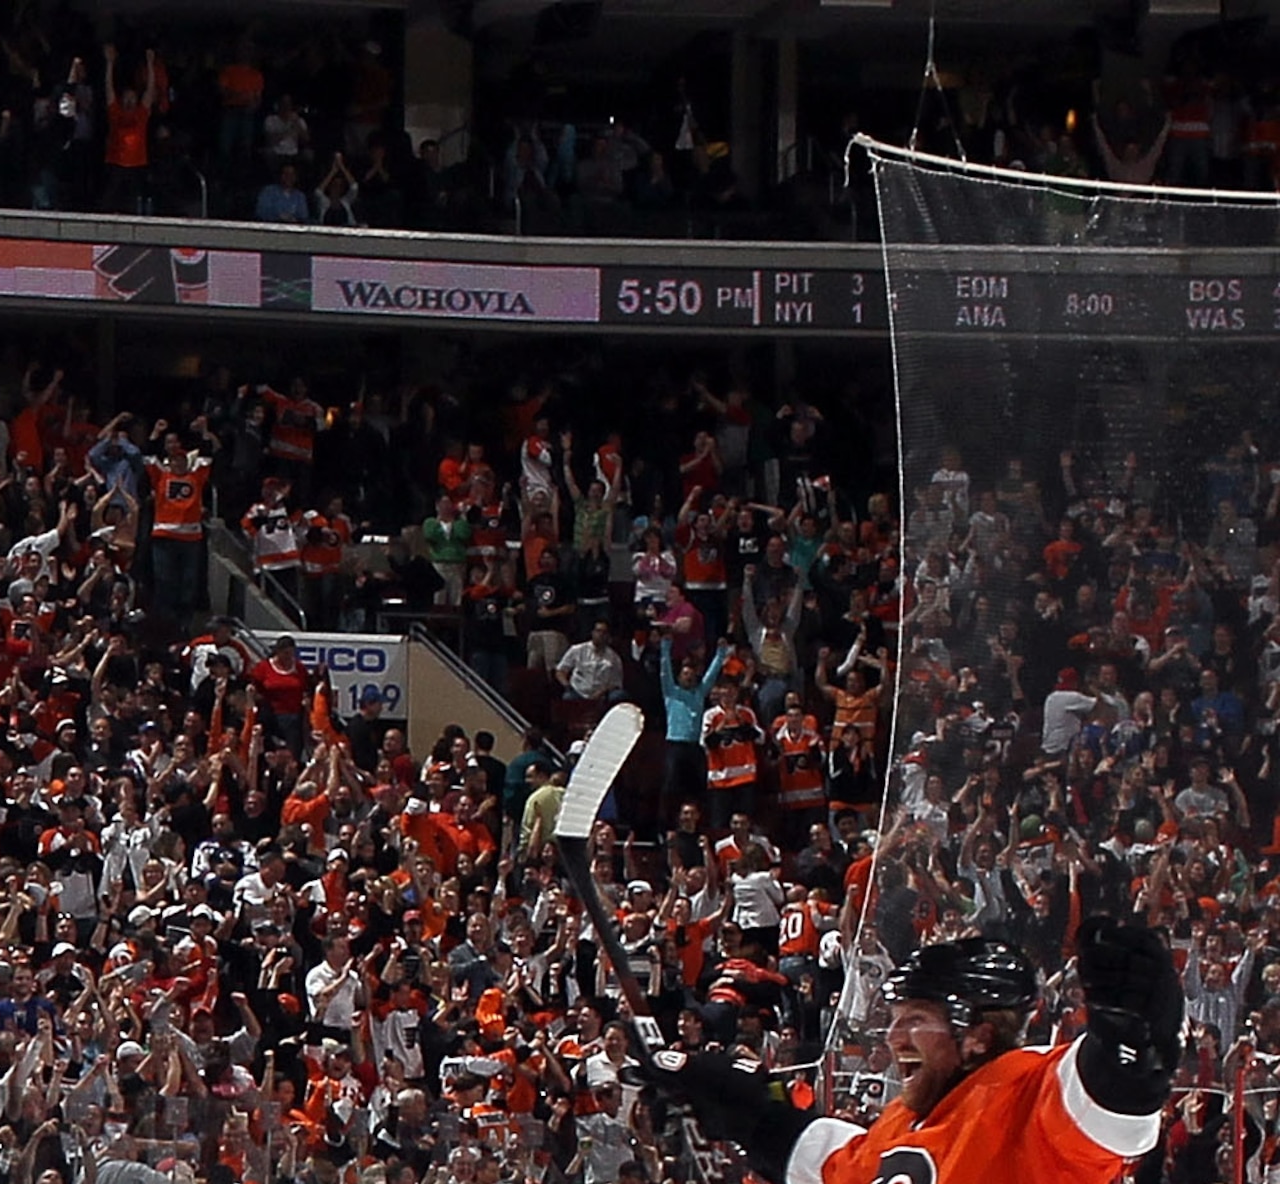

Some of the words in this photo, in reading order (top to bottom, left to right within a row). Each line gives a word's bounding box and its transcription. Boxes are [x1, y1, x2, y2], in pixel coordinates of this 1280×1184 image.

[335, 278, 536, 315] WACHOVIA
[774, 273, 814, 296] PIT
[851, 273, 865, 296] 3
[956, 276, 1009, 300] EDM
[1189, 279, 1242, 302] BOS
[616, 279, 702, 316] 5:50
[716, 286, 752, 309] PM
[774, 302, 814, 324] NYI
[851, 303, 863, 324] 1
[955, 304, 1008, 328] ANA
[1186, 307, 1246, 330] WAS
[292, 645, 386, 673] EICO
